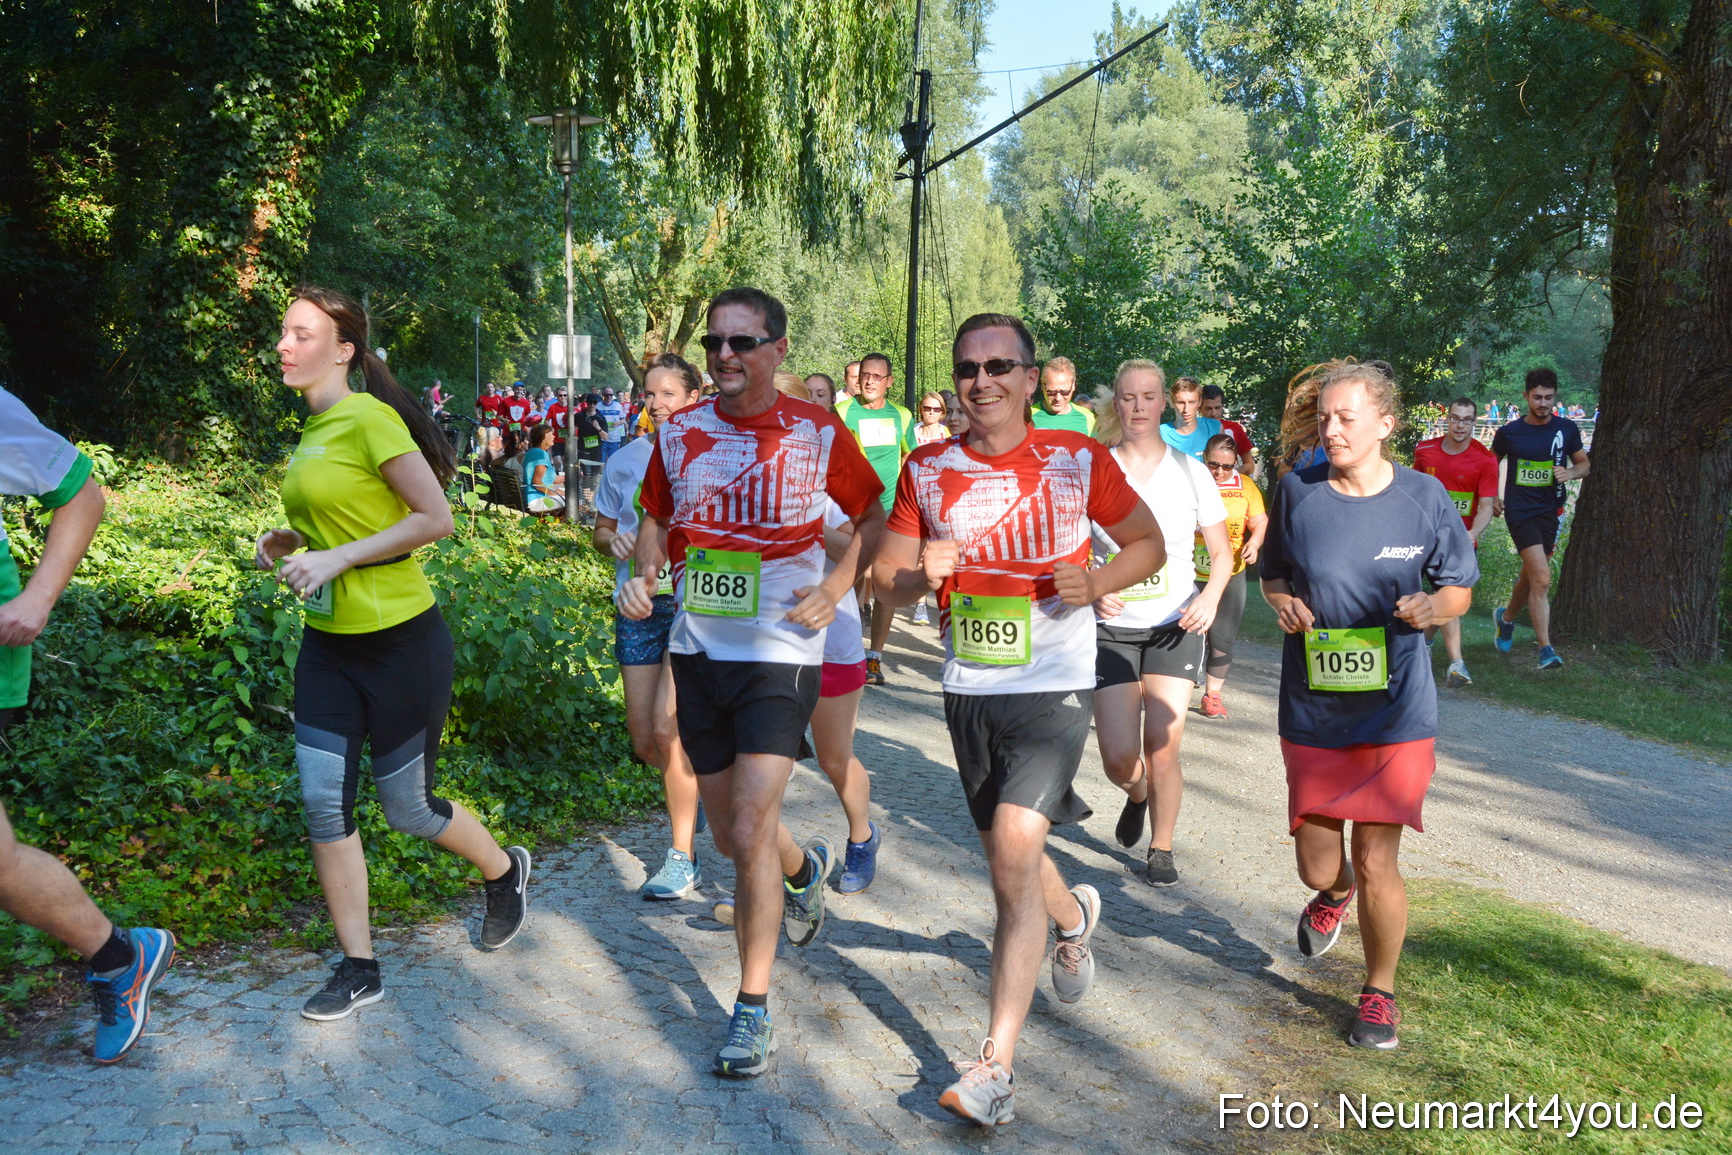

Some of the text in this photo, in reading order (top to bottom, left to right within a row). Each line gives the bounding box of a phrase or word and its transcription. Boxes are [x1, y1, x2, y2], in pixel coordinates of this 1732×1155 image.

[701, 471, 728, 480] 26.22
[1521, 469, 1549, 479] 1606
[968, 512, 994, 522] 26.22
[691, 571, 747, 598] 1868
[720, 598, 742, 606] Stefan
[959, 618, 1018, 645] 1869
[987, 645, 1017, 653] Matthias
[1315, 651, 1375, 673] 1059
